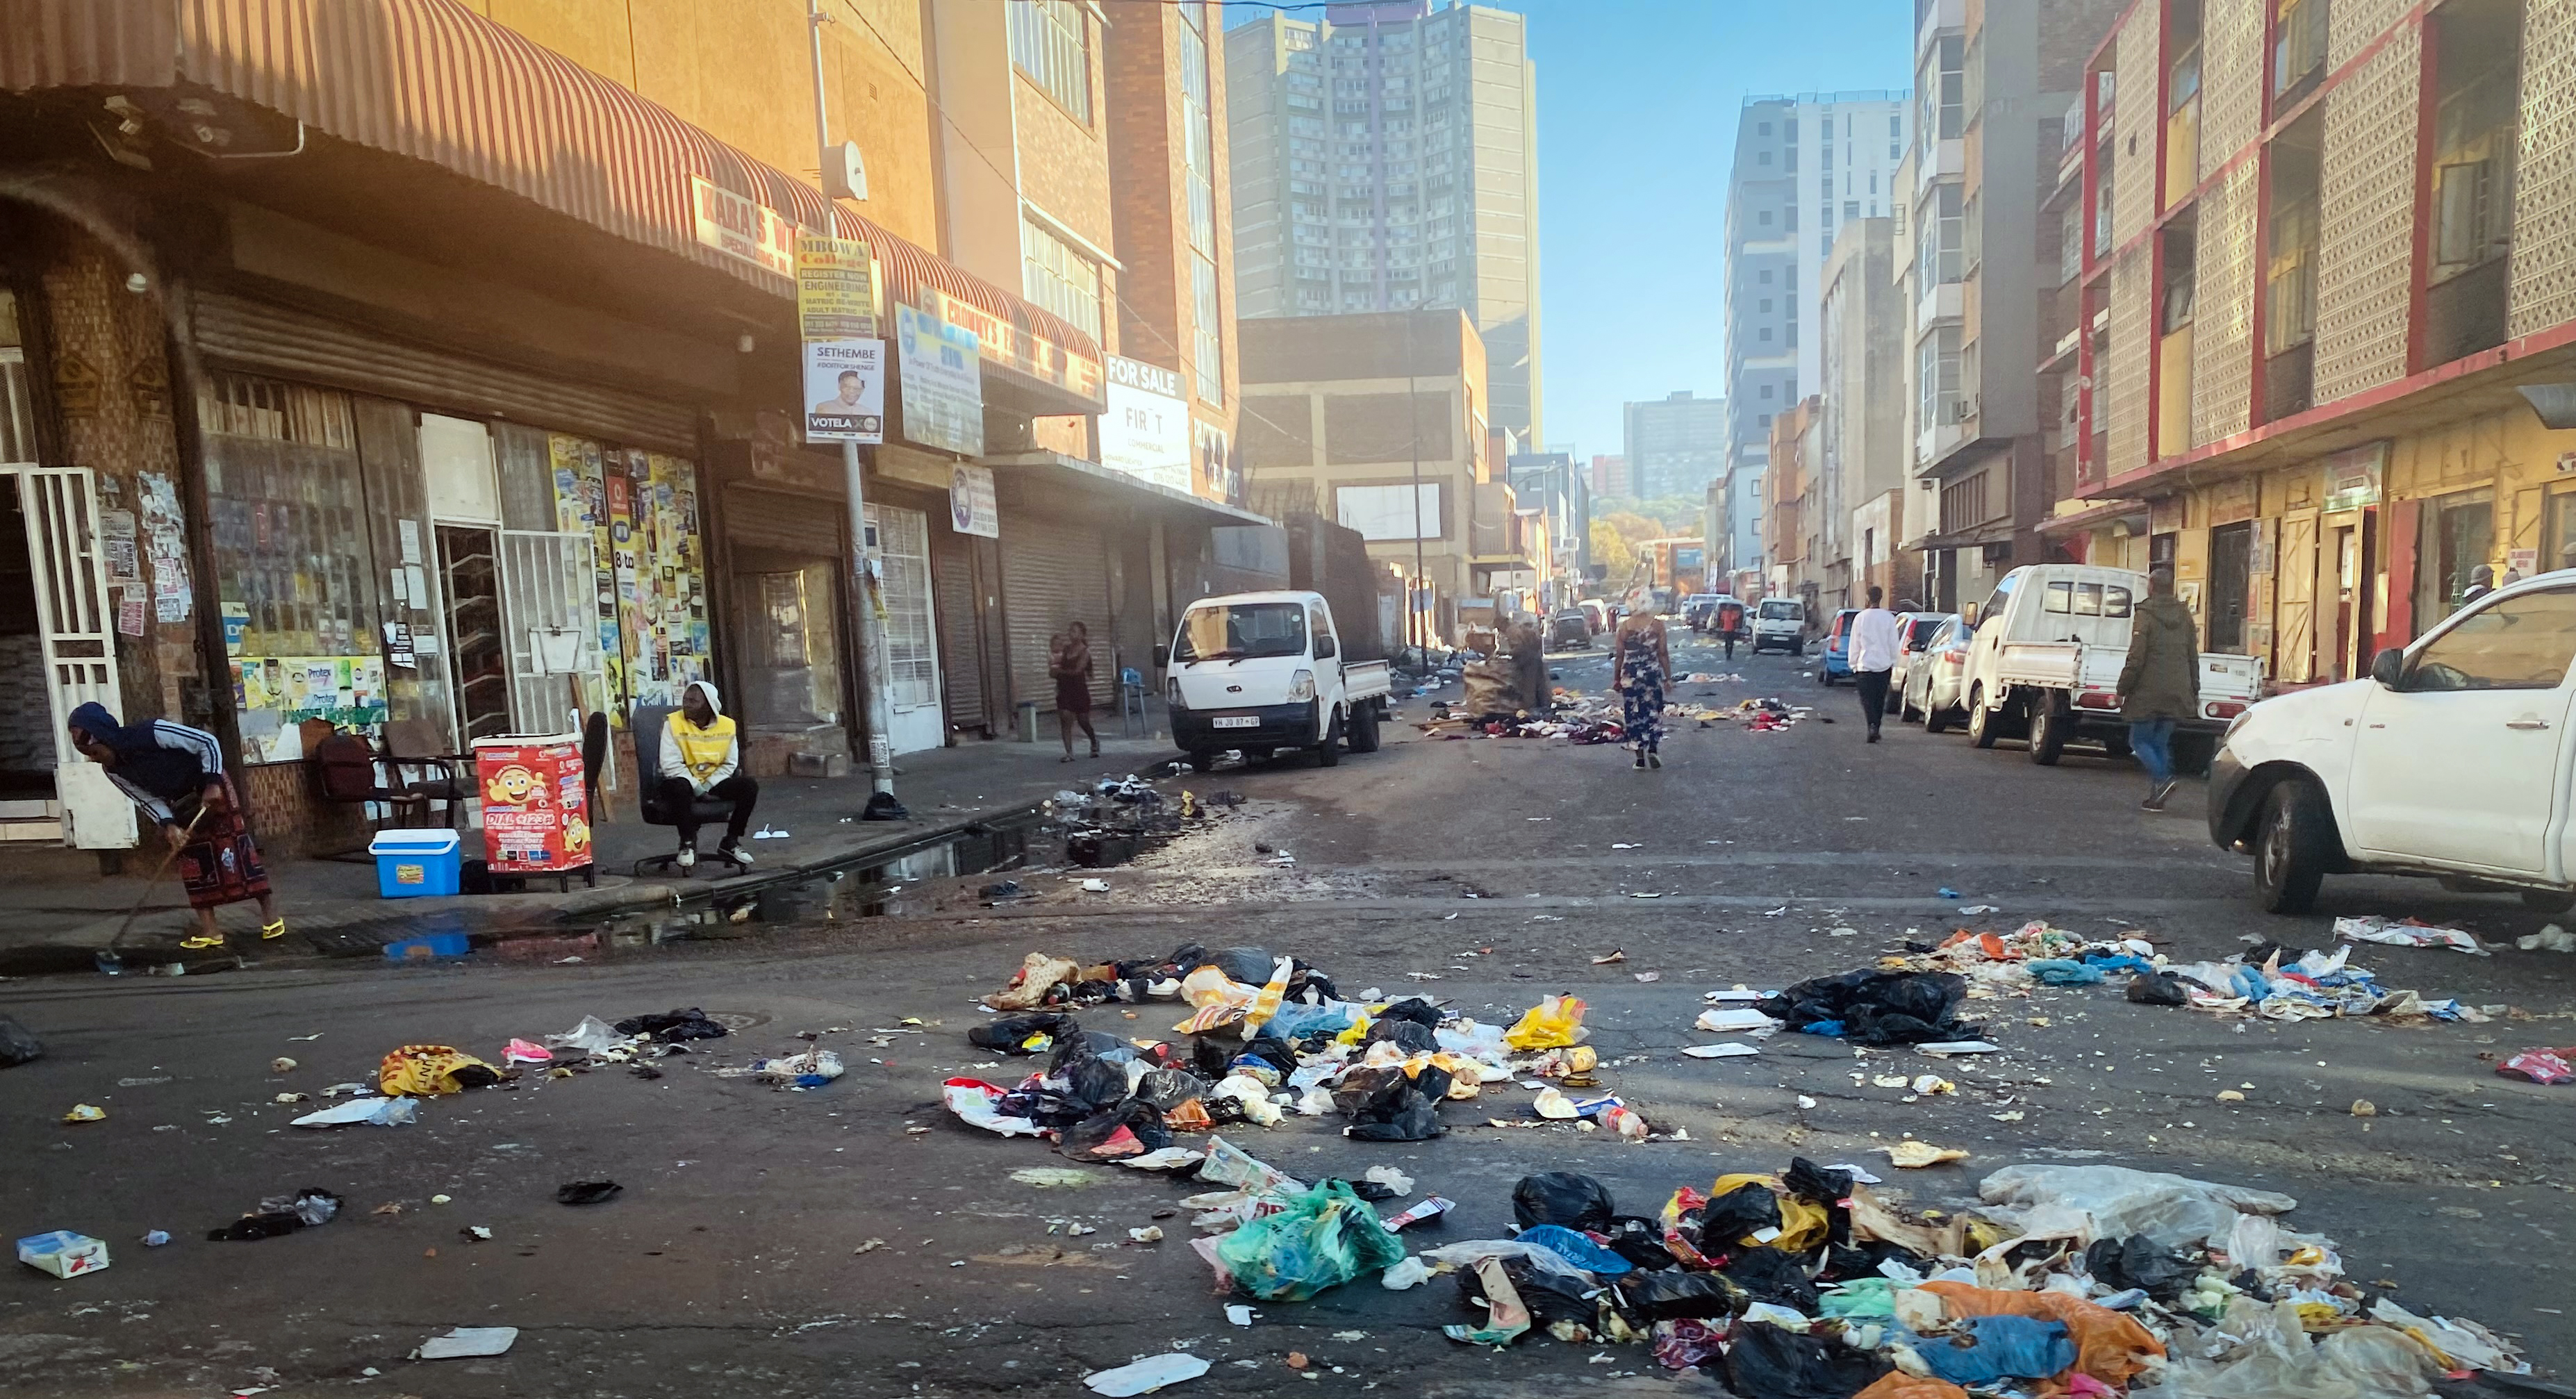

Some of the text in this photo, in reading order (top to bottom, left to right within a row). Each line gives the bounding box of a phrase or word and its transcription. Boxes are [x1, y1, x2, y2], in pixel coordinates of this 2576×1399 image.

[700, 183, 766, 244] KARA'S
[721, 232, 775, 268] SPECIALISING
[800, 240, 865, 256] MBOWA
[801, 269, 868, 281] REGISTER NOW
[804, 281, 868, 293] ENGINEERING
[816, 347, 875, 359] SETHEMBE
[1107, 356, 1139, 386] FOR
[1140, 365, 1176, 397] SALE
[810, 417, 852, 429] VOTELA
[1125, 406, 1162, 434] FIRT
[1128, 438, 1164, 454] COMMERCIAL
[1207, 462, 1239, 498] CENTRE
[308, 668, 332, 679] Protex
[486, 812, 515, 825] DIAL
